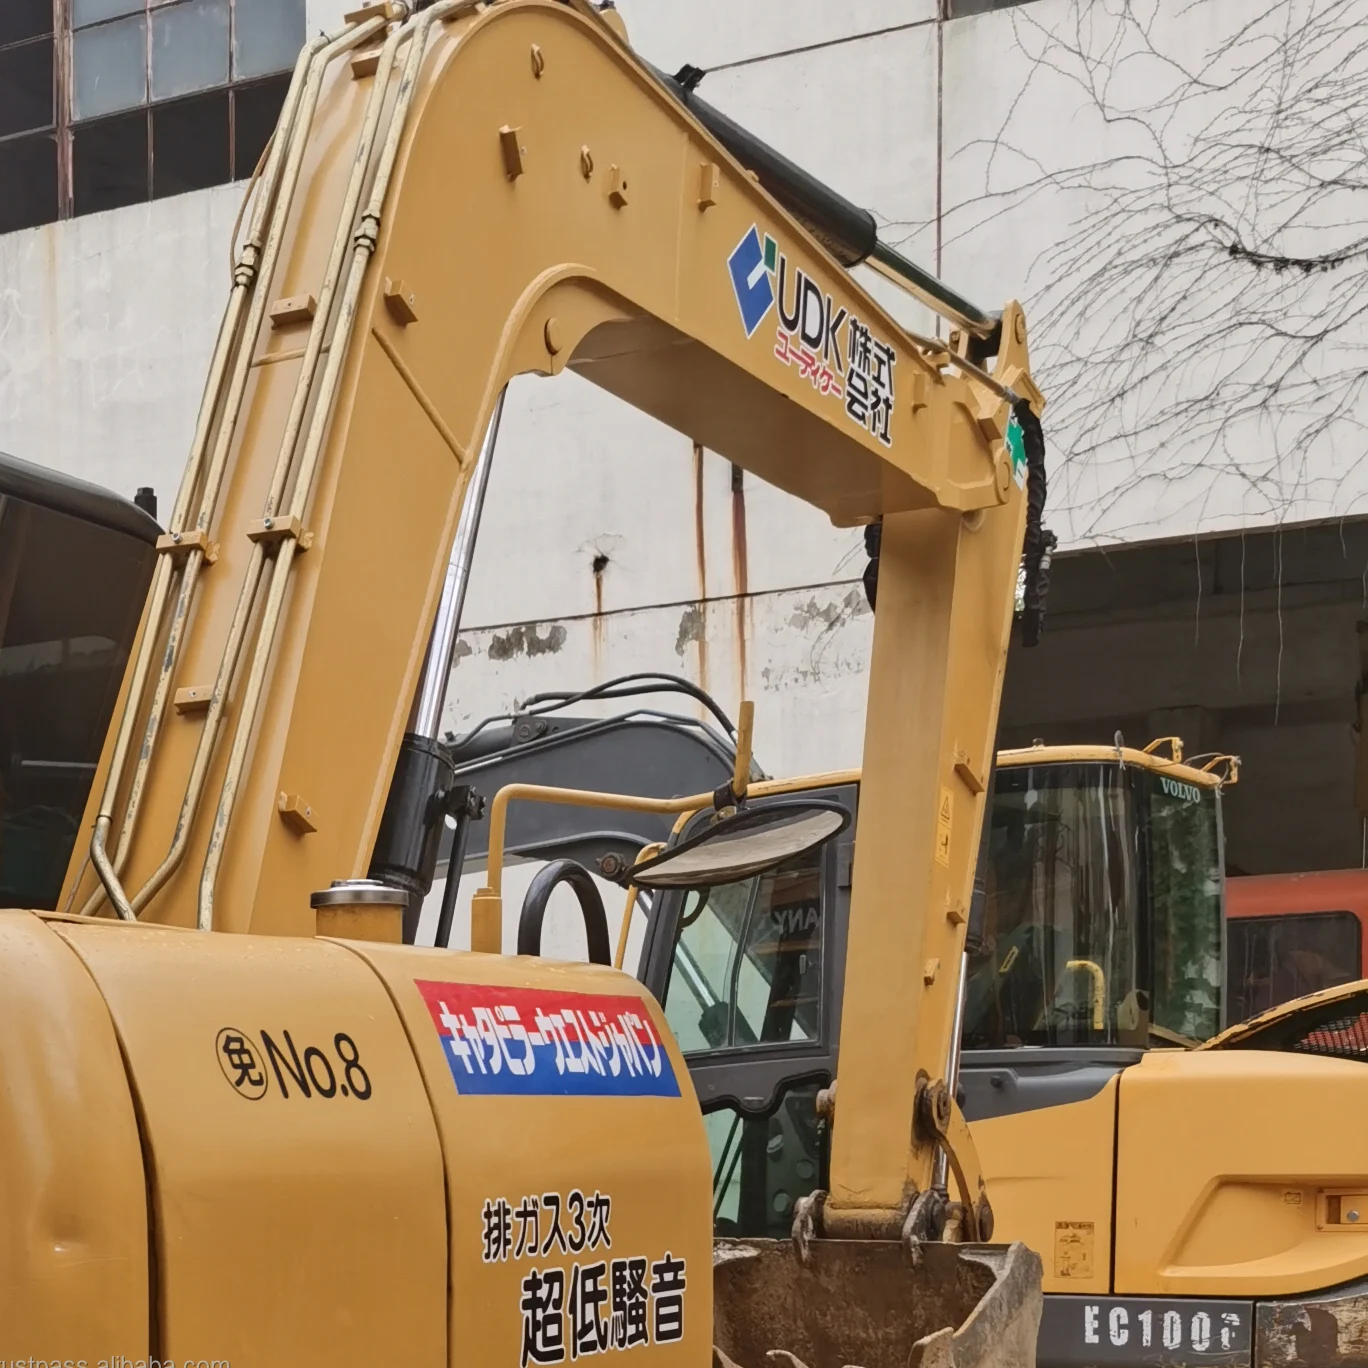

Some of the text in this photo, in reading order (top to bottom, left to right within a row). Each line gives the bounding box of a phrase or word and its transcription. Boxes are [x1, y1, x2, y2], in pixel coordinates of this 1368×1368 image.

[778, 255, 846, 373] UDK
[775, 331, 842, 398] ユーディケー
[848, 316, 897, 395] 株式
[846, 370, 894, 447] 会社
[1160, 776, 1201, 804] VOLVO
[260, 1029, 372, 1100] No.8
[438, 1000, 662, 1078] キャタピラーウエストジャパン
[482, 1190, 612, 1262] 排ガス3次
